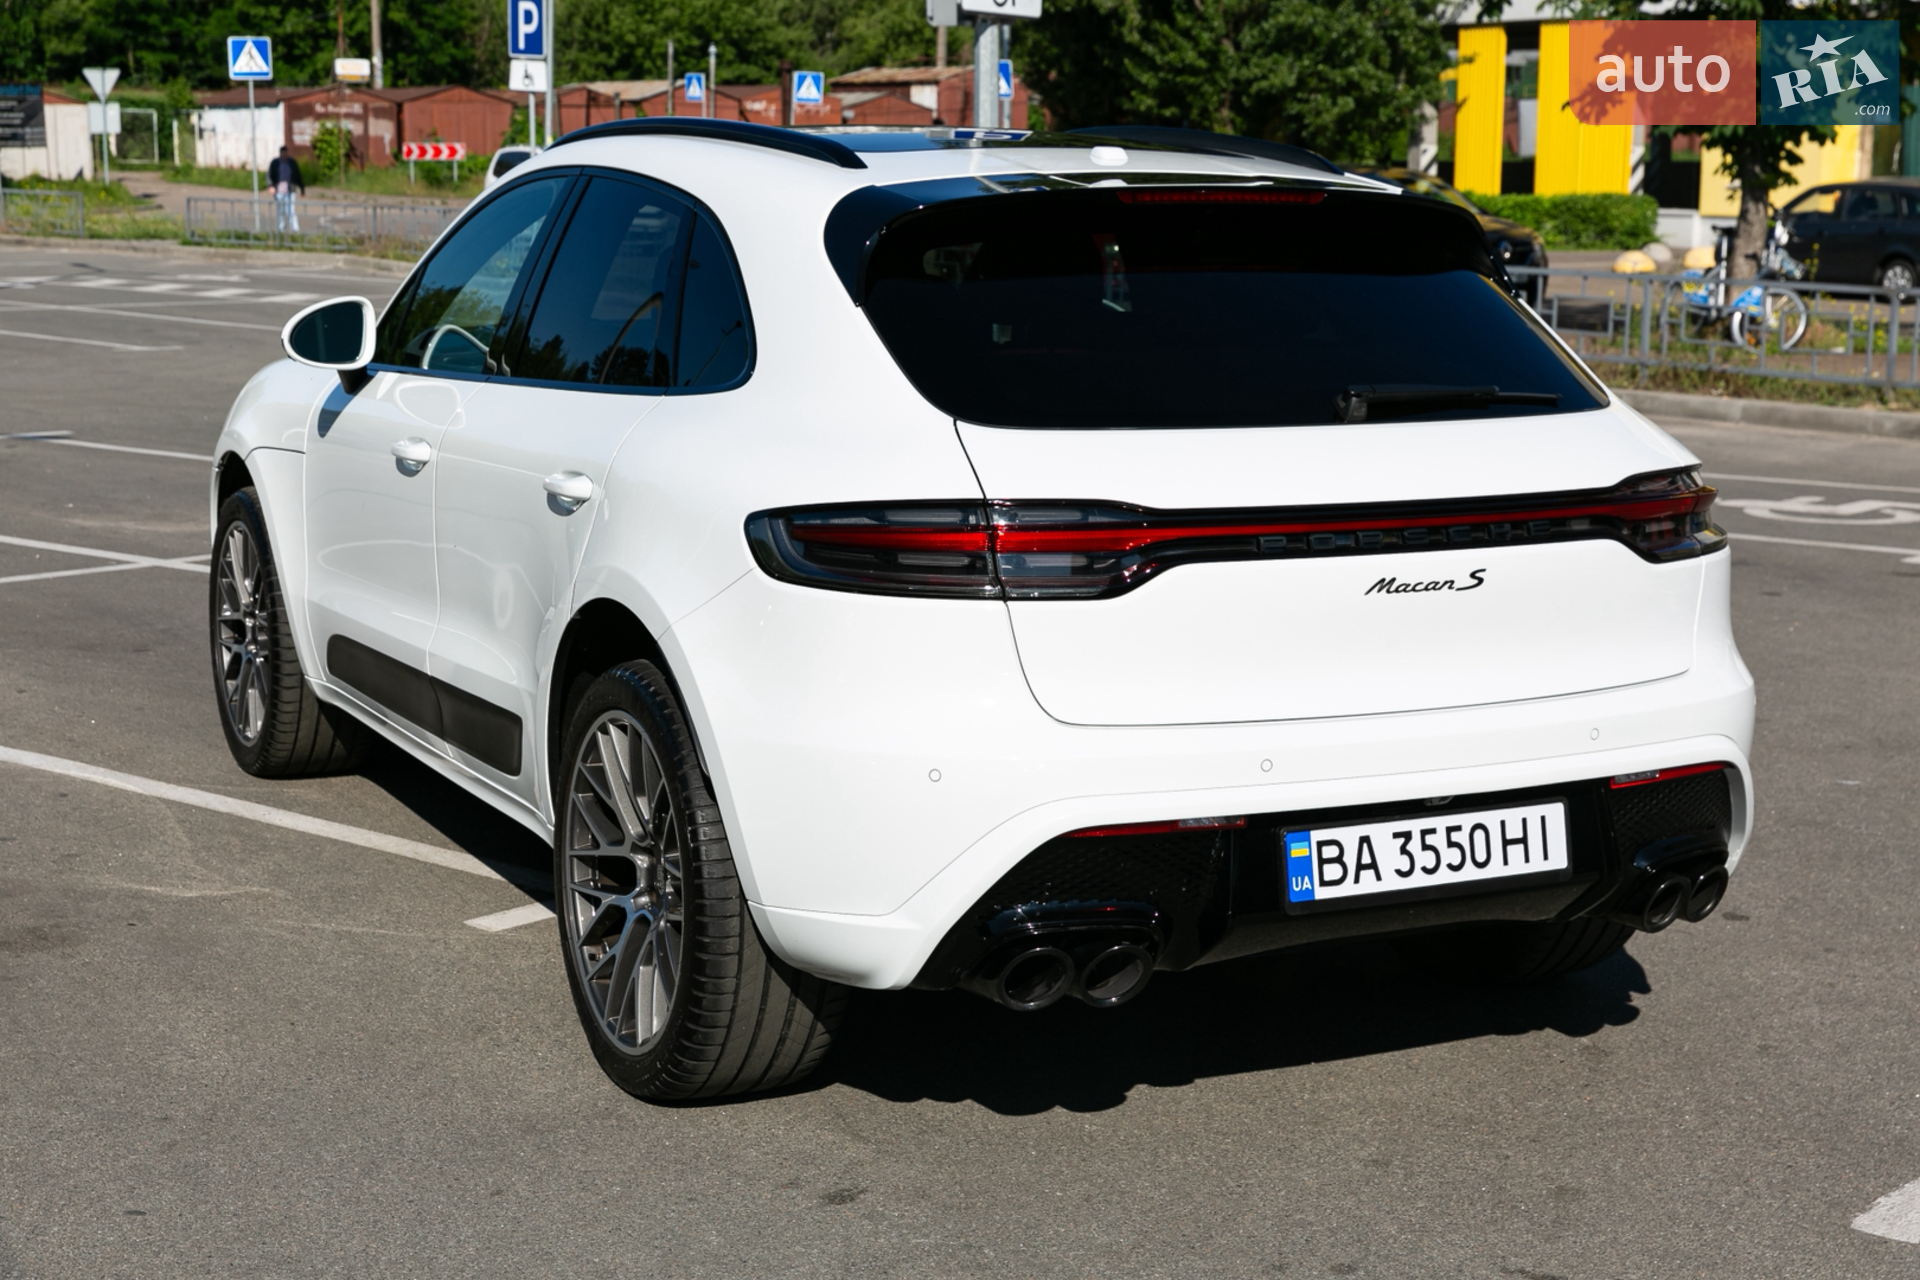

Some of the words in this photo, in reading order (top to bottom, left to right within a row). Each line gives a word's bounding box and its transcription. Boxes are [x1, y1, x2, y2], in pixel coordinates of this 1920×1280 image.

[517, 0, 540, 51] P
[1257, 520, 1552, 555] PORSCHE
[1364, 577, 1455, 595] Macan
[1455, 568, 1487, 592] S
[1316, 834, 1382, 887] BA
[1392, 822, 1491, 878] 3550
[1500, 815, 1549, 866] HI
[1292, 875, 1312, 892] UA
